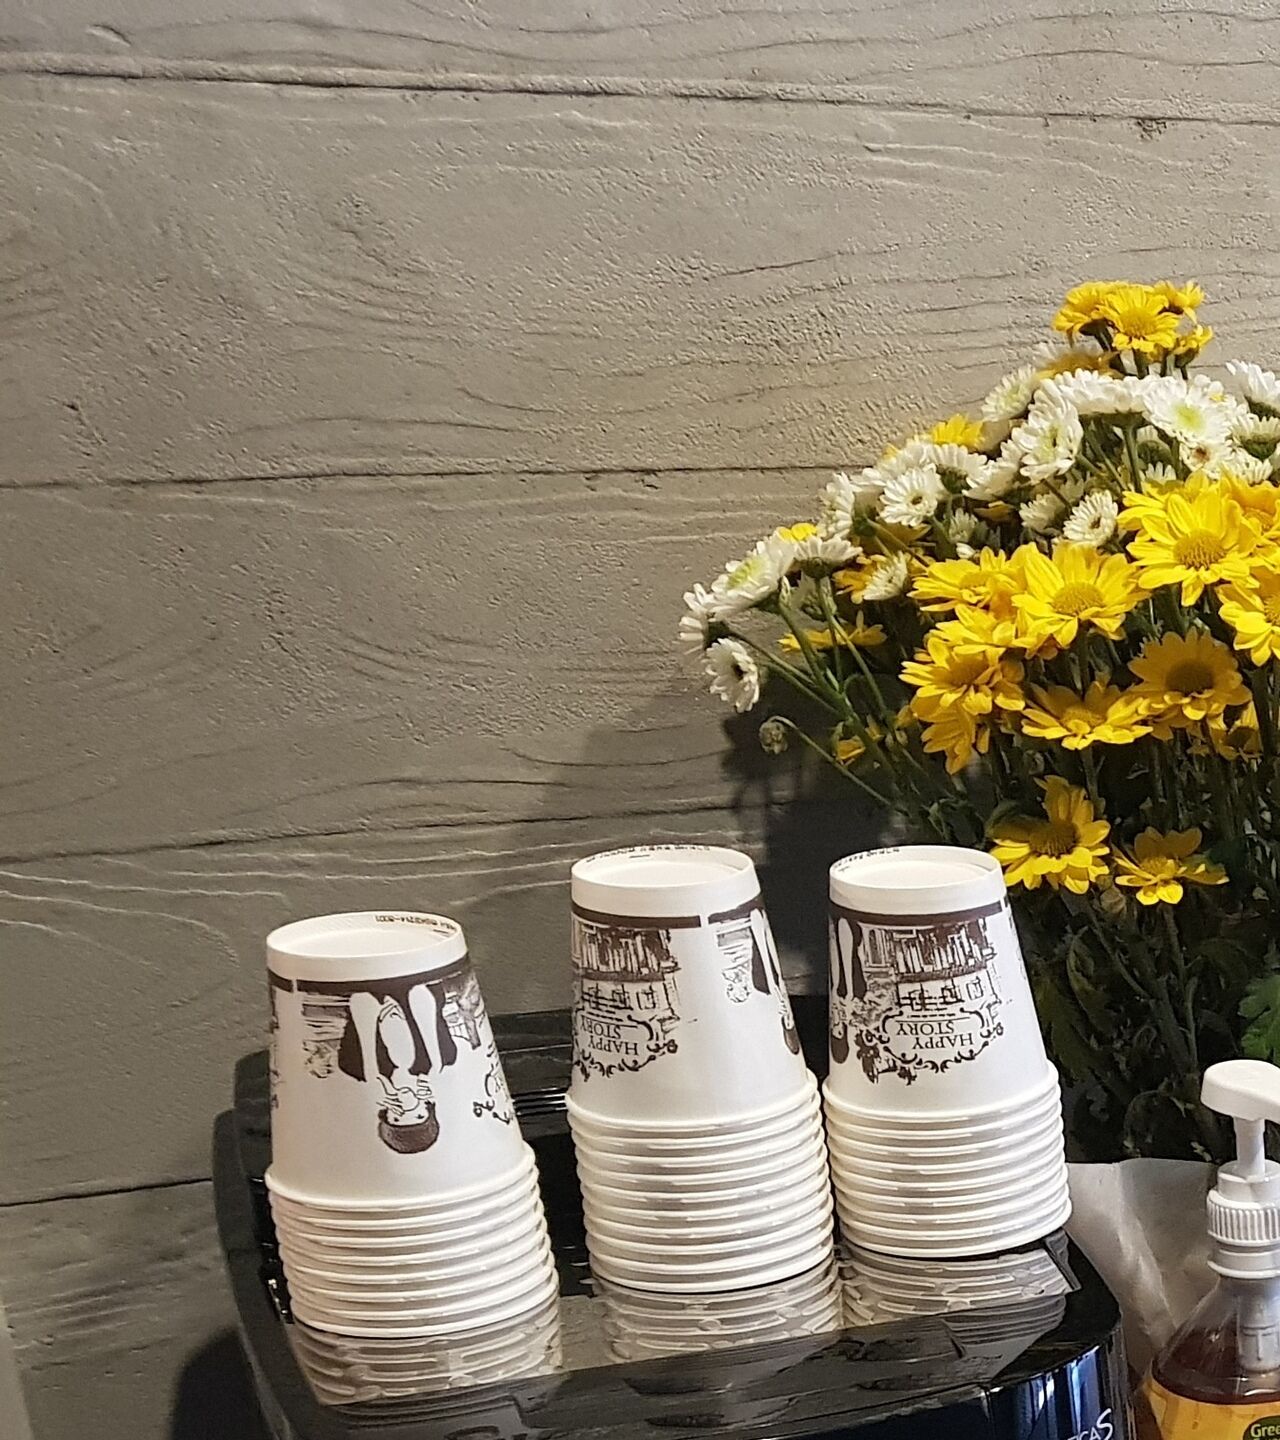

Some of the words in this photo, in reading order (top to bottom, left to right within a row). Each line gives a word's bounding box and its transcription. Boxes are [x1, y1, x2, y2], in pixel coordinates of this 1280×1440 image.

[580, 1017, 622, 1039] STORY
[897, 1021, 956, 1036] STORY
[588, 1034, 639, 1056] HAPPY
[912, 1033, 974, 1050] HAPPY
